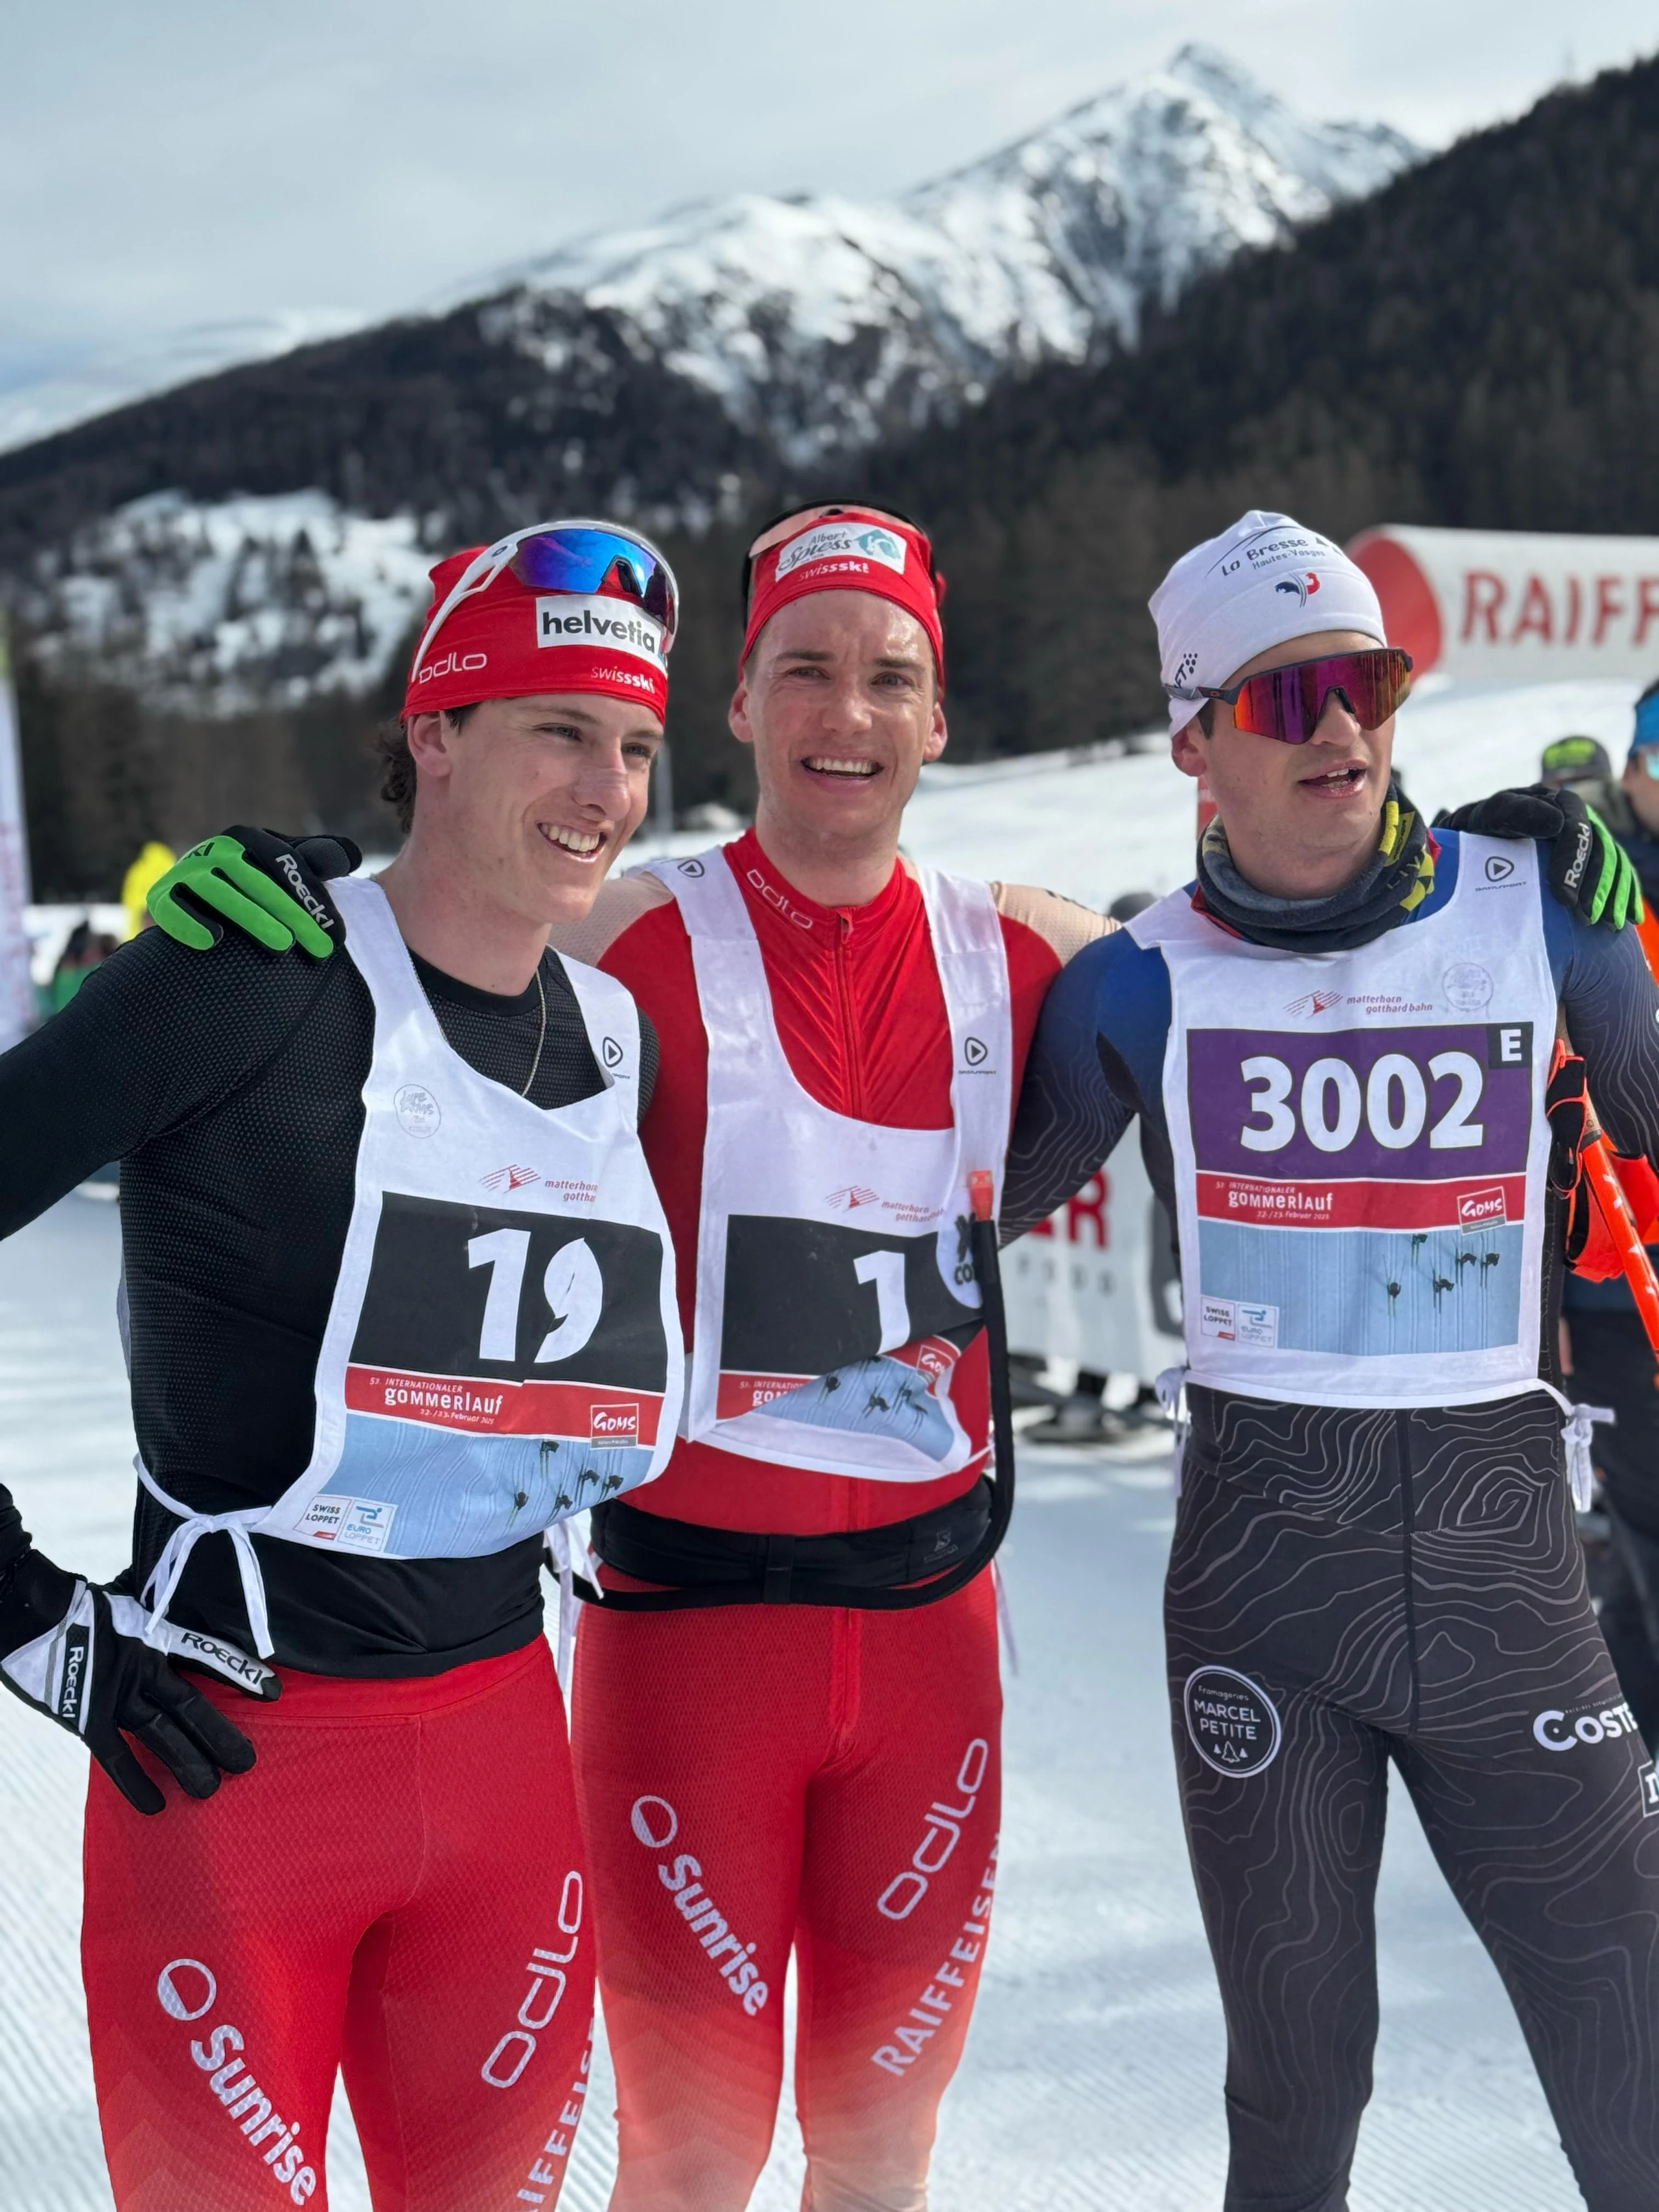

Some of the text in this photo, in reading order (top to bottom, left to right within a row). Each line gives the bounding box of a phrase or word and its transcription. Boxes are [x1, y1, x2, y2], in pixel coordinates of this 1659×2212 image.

[809, 531, 847, 544] Albert
[1222, 537, 1308, 577] La Bresse
[1252, 549, 1326, 570] Hautes-Vosges
[543, 610, 655, 654] helvetia
[747, 869, 813, 929] odlo
[1347, 994, 1402, 1004] matterhorn
[1365, 1002, 1433, 1015] gotthard bahn
[1500, 1028, 1522, 1062] E
[1240, 1051, 1483, 1152] 3002
[1229, 1182, 1295, 1193] INTERNATIONALER
[881, 1201, 929, 1214] matterhorn
[1285, 1210, 1311, 1219] Februar
[467, 1228, 603, 1363] 19
[853, 1250, 911, 1354] 1
[1206, 1306, 1229, 1317] SWISS
[1203, 1315, 1232, 1327] LOPPET
[386, 1377, 463, 1393] INTERNATIONALER
[451, 1412, 479, 1422] Februar
[313, 1504, 341, 1514] SWISS
[305, 1513, 340, 1524] LOPPET
[347, 1524, 371, 1534] EURO
[344, 1532, 380, 1544] LOPPET
[1198, 1685, 1249, 1701] Fromageries
[1194, 1699, 1261, 1722] MARCEL
[1200, 1718, 1257, 1740] PETITE
[877, 1738, 989, 1920] odlo
[658, 1854, 769, 2016] Sunrise
[481, 1870, 583, 2089] odlo
[191, 2024, 317, 2206] Sunrise
